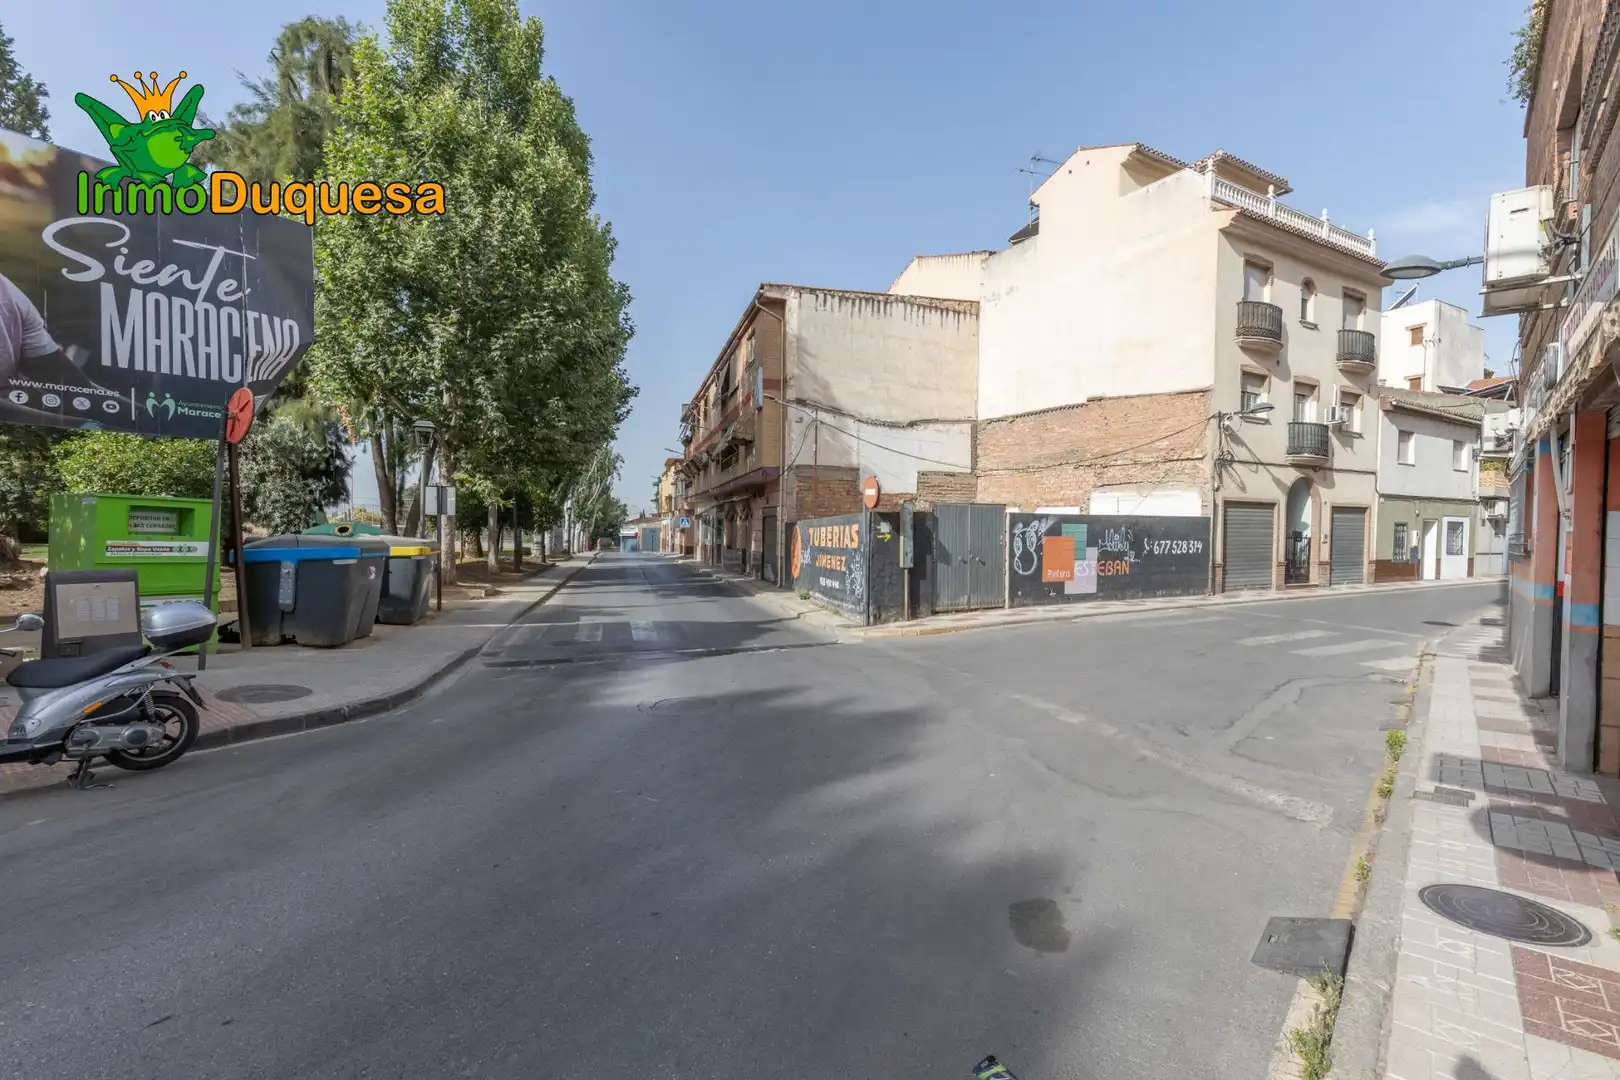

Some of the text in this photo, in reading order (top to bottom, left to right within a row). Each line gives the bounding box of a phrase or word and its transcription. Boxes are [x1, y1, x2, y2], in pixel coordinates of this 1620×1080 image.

[9, 378, 120, 397] www.maracena.es
[178, 407, 221, 418] Marace
[809, 524, 859, 548] TUBERIAS
[816, 554, 847, 572] JIMENEZ
[1075, 560, 1130, 577] ESTEBAN
